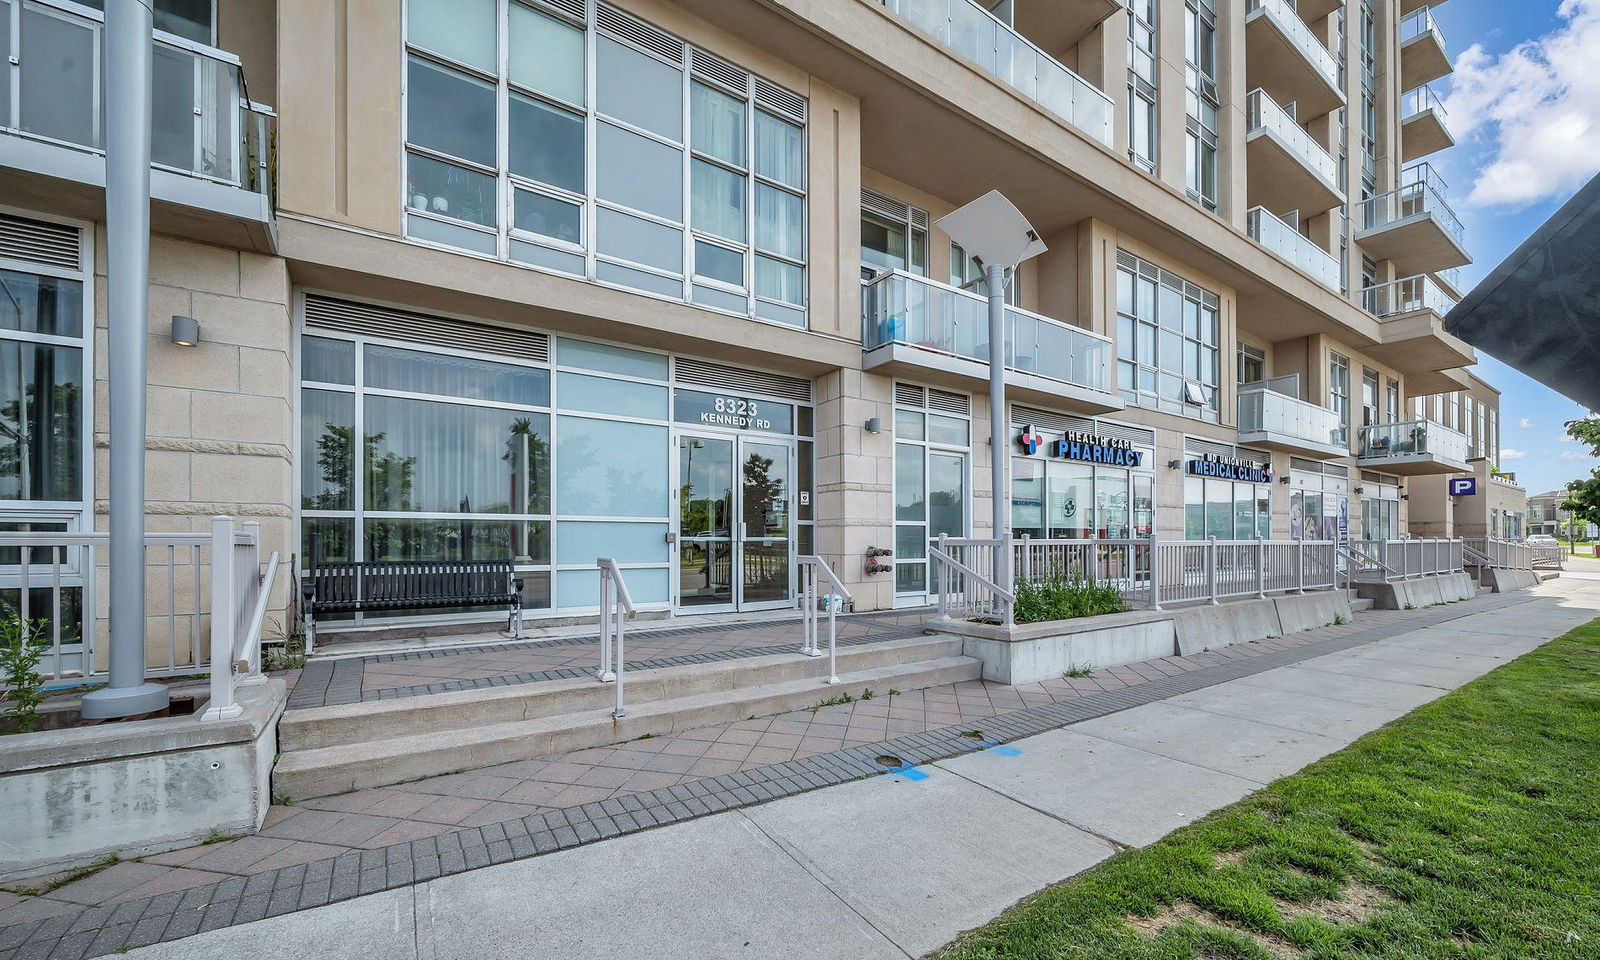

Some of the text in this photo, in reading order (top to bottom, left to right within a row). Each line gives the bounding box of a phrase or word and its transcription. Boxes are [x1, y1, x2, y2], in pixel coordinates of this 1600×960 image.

[715, 397, 758, 417] 8323
[701, 412, 770, 429] KENNEDY RD
[1068, 430, 1135, 450] HEALTH CARE
[1058, 440, 1143, 467] PHARMACY
[1207, 453, 1257, 469] MD UNIONVILLE
[1195, 460, 1267, 482] MEDICAL CLINIC
[1455, 481, 1472, 494] P
